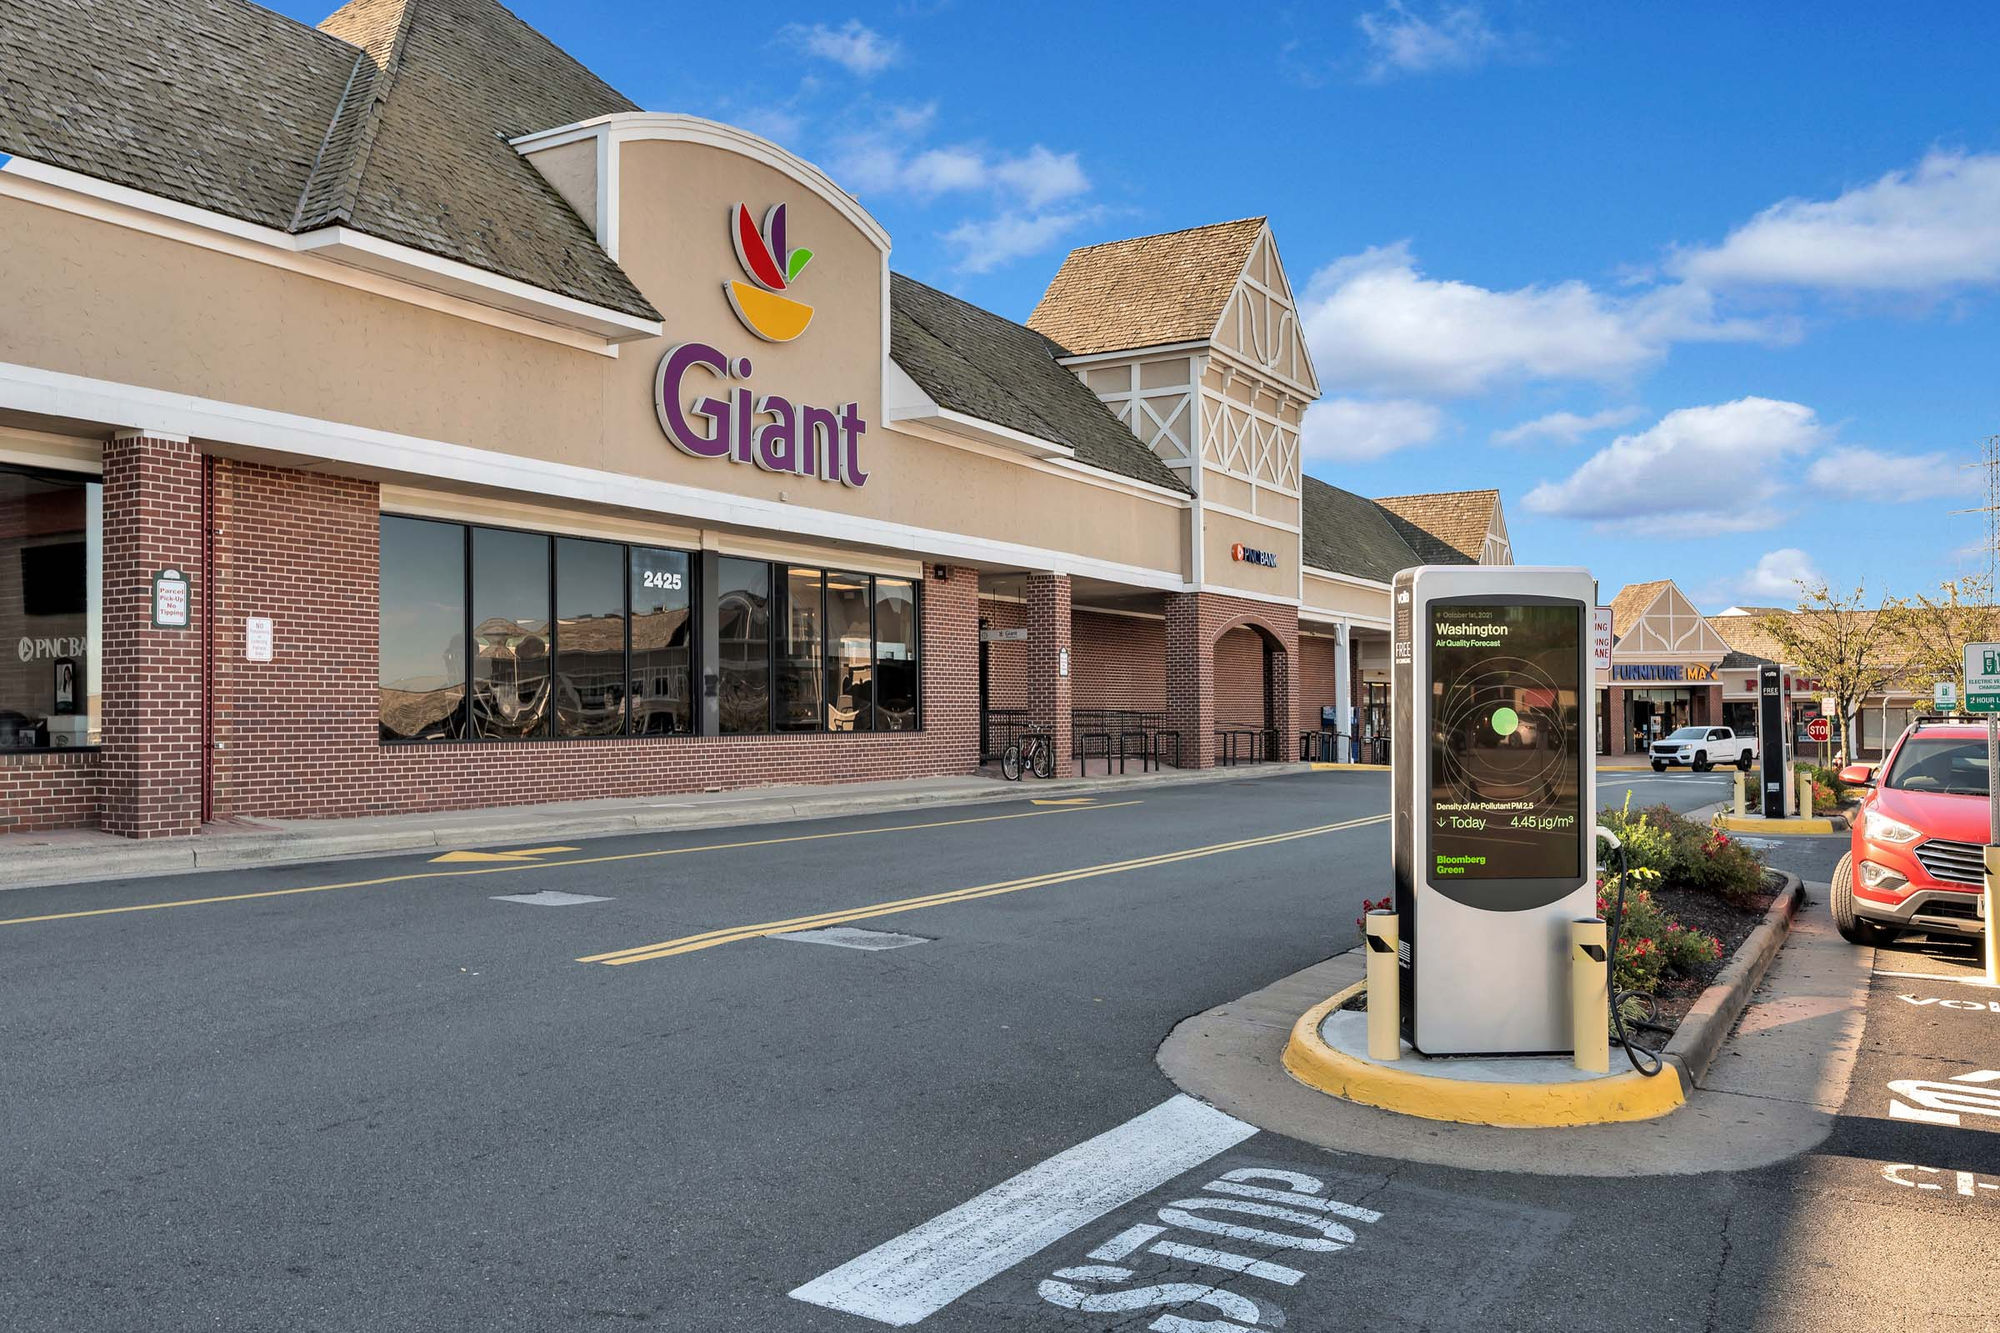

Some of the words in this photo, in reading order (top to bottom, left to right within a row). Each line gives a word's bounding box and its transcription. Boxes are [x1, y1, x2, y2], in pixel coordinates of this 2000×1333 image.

[655, 342, 870, 488] Giant
[1260, 550, 1277, 568] BANK
[643, 571, 682, 590] 2425
[160, 595, 184, 603] Pick-Up
[160, 609, 184, 617] Tipping
[1435, 623, 1508, 637] Washington
[35, 637, 68, 658] PNC
[69, 637, 88, 657] BA
[1395, 642, 1411, 657] FREE
[1446, 640, 1470, 648] Quality
[1594, 649, 1609, 658] ANE
[1613, 664, 1683, 680] FURNITURE
[1686, 661, 1718, 681] MAX
[1436, 803, 1462, 811] Density
[1450, 816, 1486, 830] Today
[1510, 816, 1536, 828] 4.45
[1437, 855, 1486, 865] Bloomberg
[1437, 866, 1464, 874] Green
[1038, 1167, 1385, 1333] STOP
